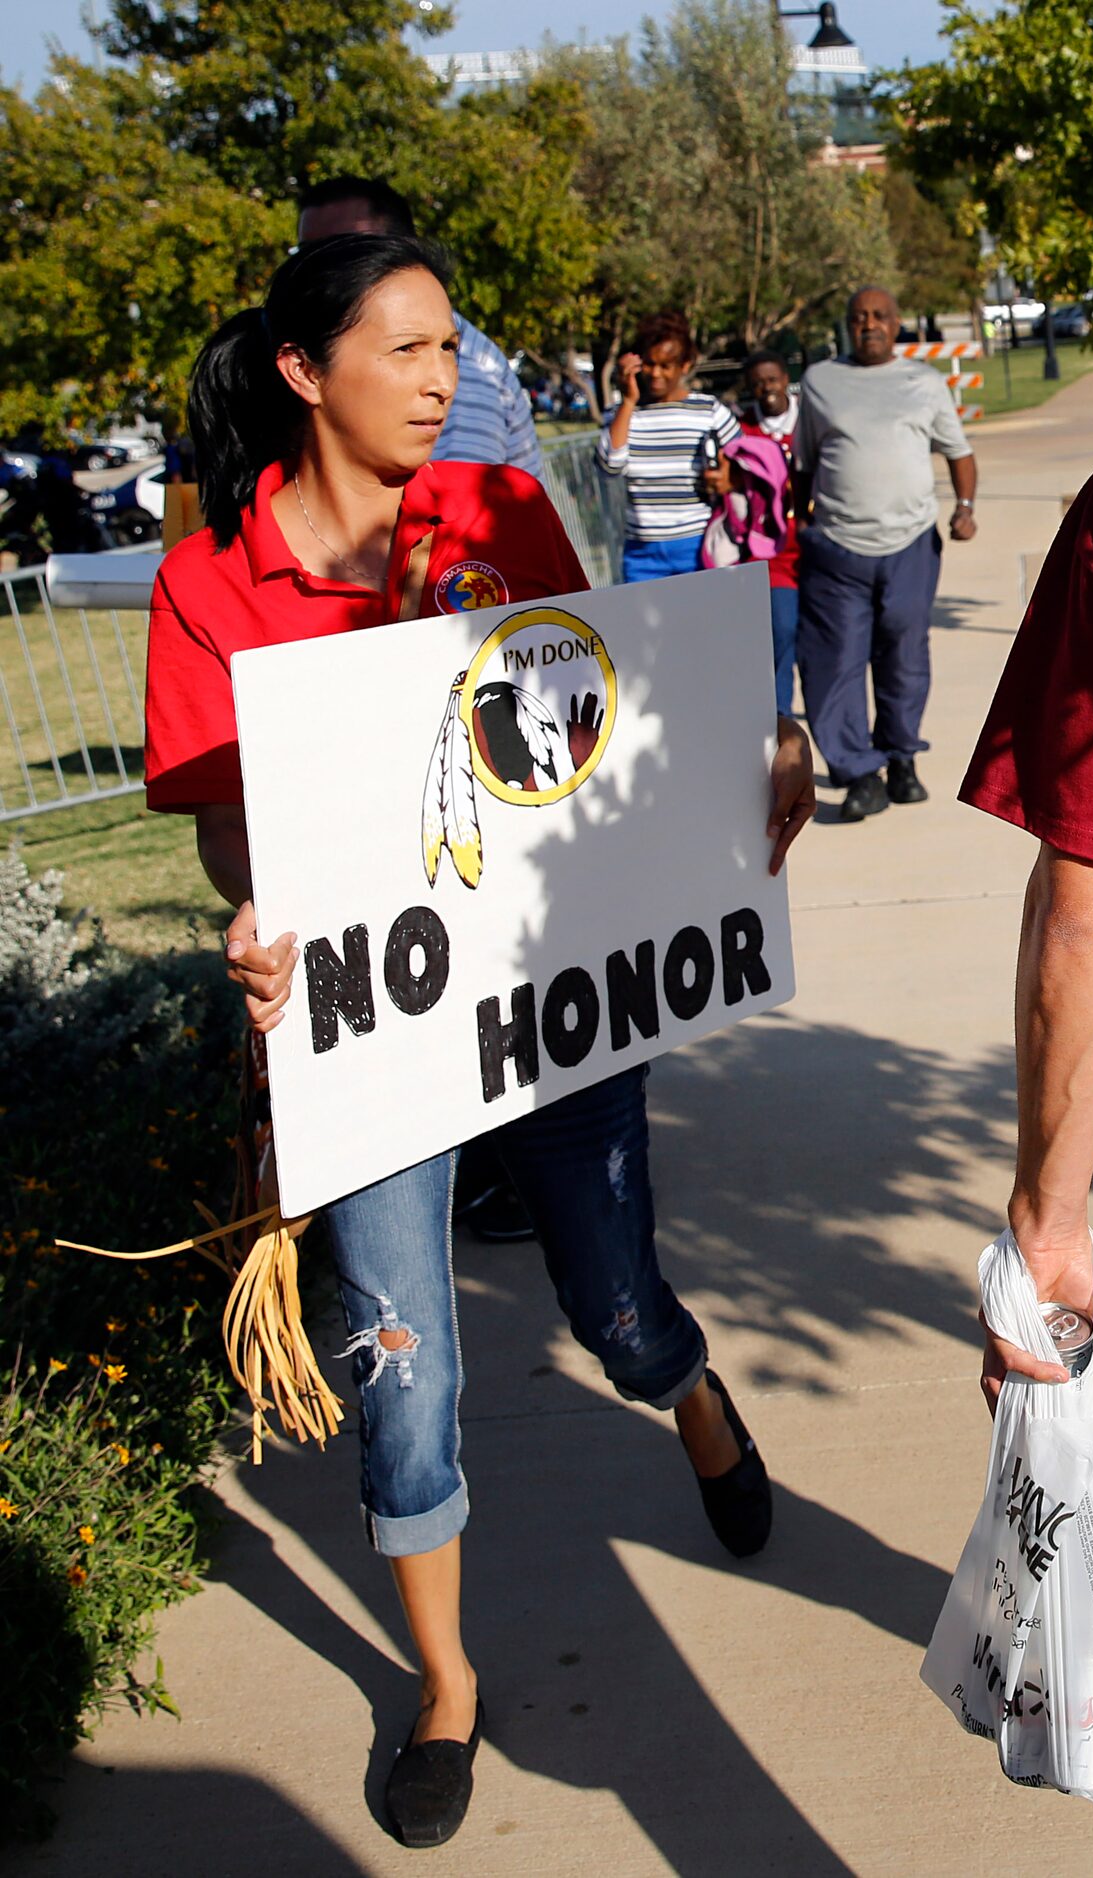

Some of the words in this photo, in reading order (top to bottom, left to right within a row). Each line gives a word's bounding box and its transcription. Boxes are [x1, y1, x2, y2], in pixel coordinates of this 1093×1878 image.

[438, 562, 494, 594] COMANCHE
[502, 646, 535, 673] I'M
[541, 635, 602, 666] DONE
[304, 905, 450, 1055] NO
[475, 907, 772, 1104] HONOR
[1085, 1496, 1093, 1514] STATES
